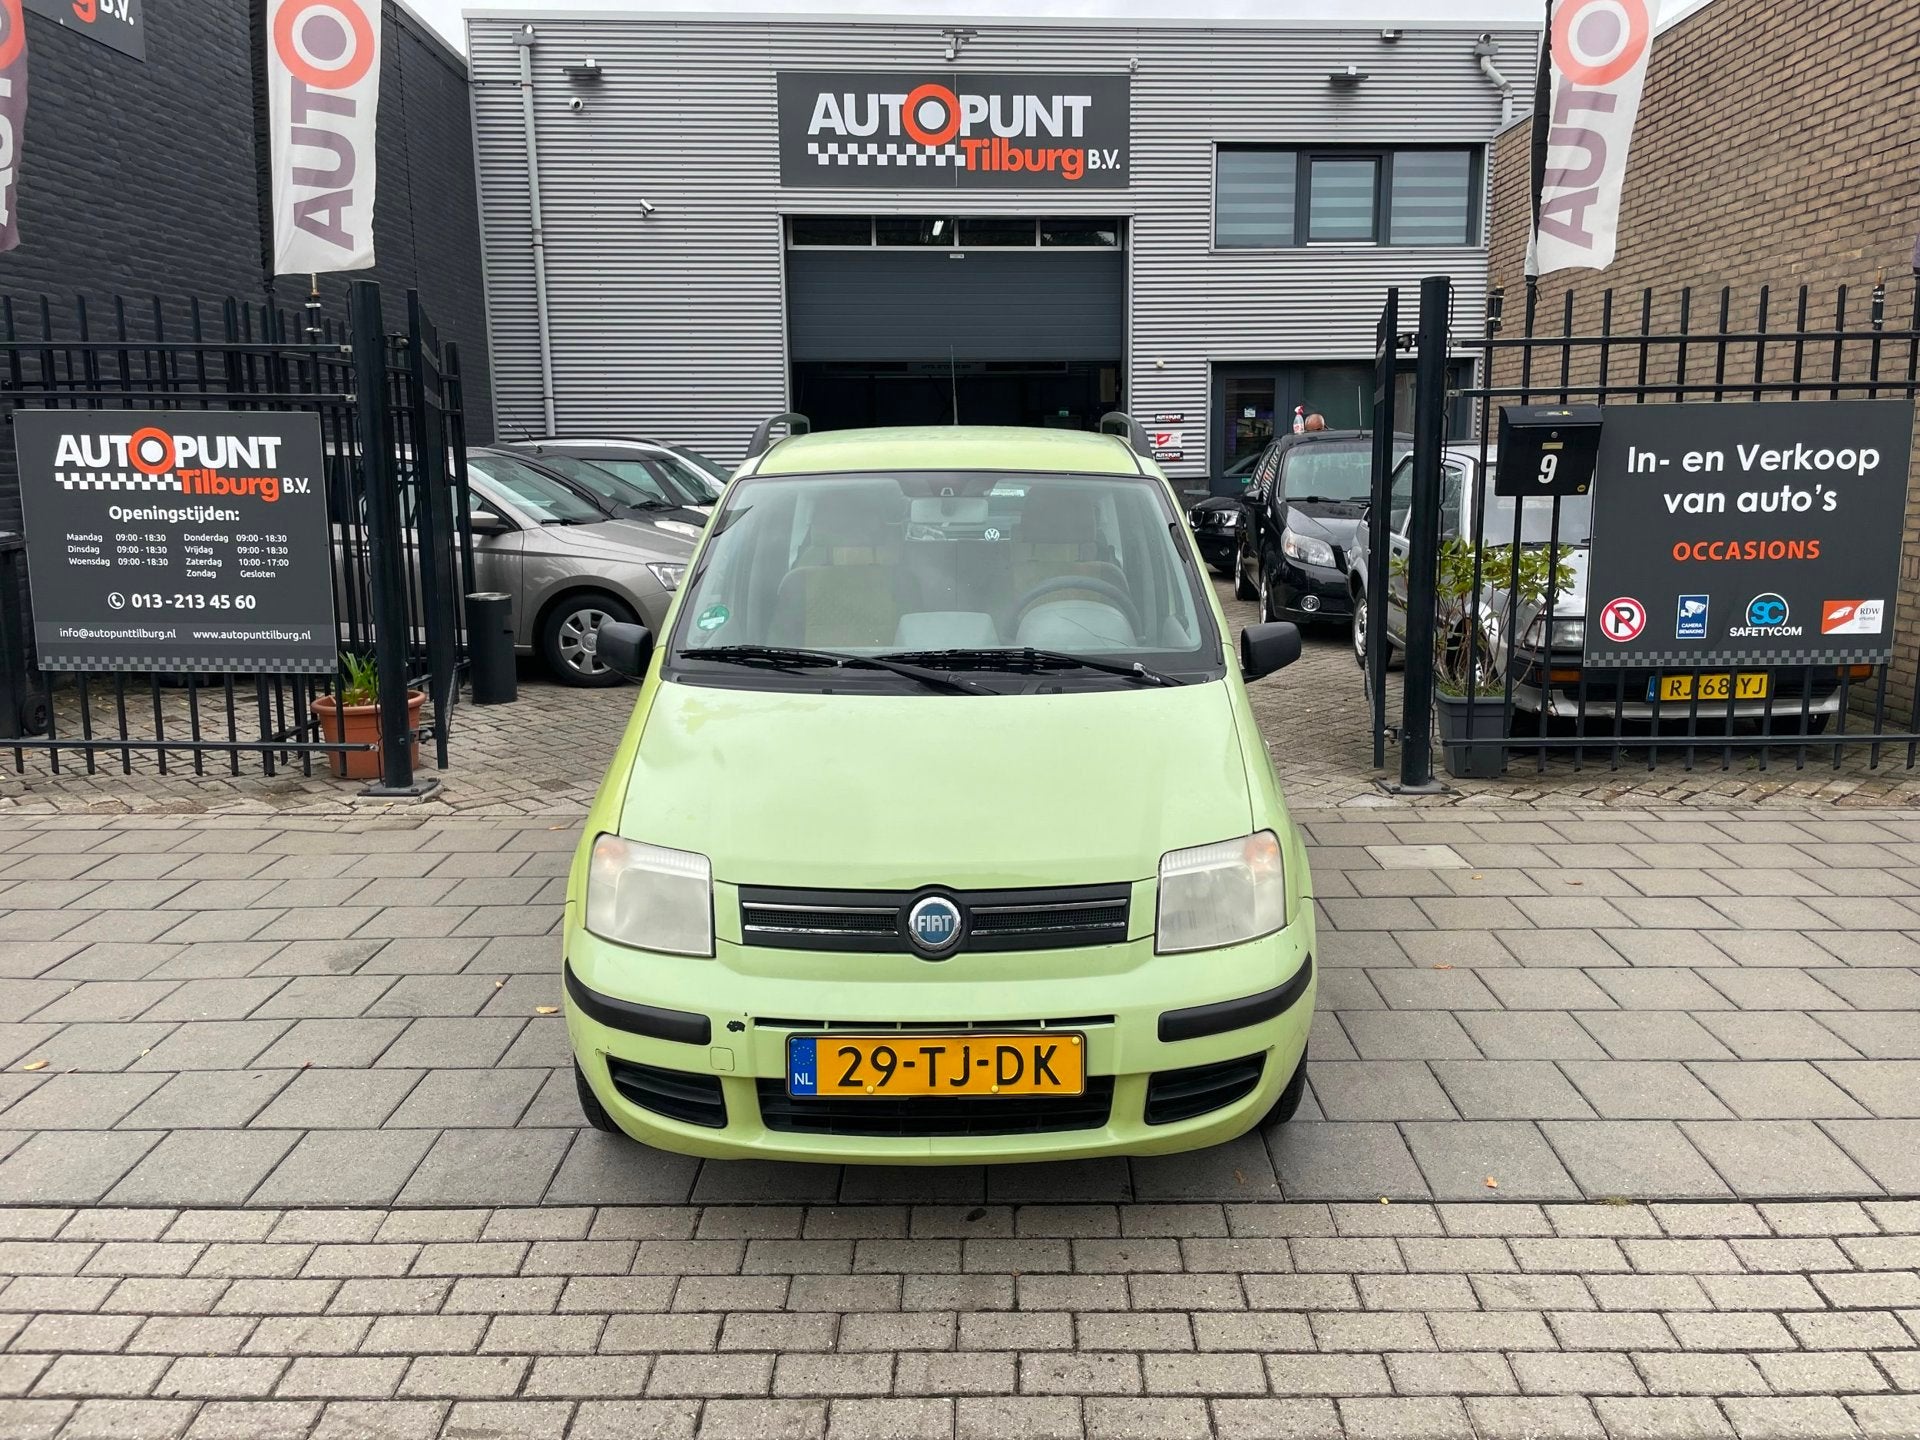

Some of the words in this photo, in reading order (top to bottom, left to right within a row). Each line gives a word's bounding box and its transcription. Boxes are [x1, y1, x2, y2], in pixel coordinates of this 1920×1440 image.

[808, 83, 1092, 147] AUTOPUNT
[273, 0, 375, 251] AUTO
[1539, 0, 1649, 250] AUTO
[961, 137, 1084, 180] Tilburg
[1088, 149, 1120, 169] B.V.
[54, 427, 282, 475] AUTOPUNT
[1628, 447, 1669, 472] In-
[1683, 451, 1723, 472] en
[1737, 443, 1879, 475] Verkoop
[1538, 454, 1557, 483] 9
[177, 469, 280, 502] Tilburg
[283, 478, 310, 493] B.V.
[1664, 493, 1725, 513] van
[109, 505, 239, 523] Openingstijden:
[67, 533, 102, 542] Maandag
[184, 534, 228, 543] Donderdag
[236, 534, 258, 542] 09:00
[68, 545, 99, 554] Dinsdag
[185, 546, 213, 555] Vrijdag
[1673, 540, 1819, 560] OCCASIONS
[69, 557, 110, 566] Woensdag
[186, 558, 222, 567] Zaterdag
[187, 569, 216, 578] Zondag
[210, 595, 230, 609] 45
[235, 595, 256, 609] 60
[1859, 607, 1881, 615] RDW
[60, 628, 176, 640] info@autopunttilburg.nl
[193, 630, 311, 641] www.autopunttilburg.nl
[1730, 627, 1802, 636] SAFETYCOM
[917, 915, 952, 933] FIAT
[837, 1045, 1061, 1087] 29-TJ-DK
[794, 1073, 813, 1086] NL
